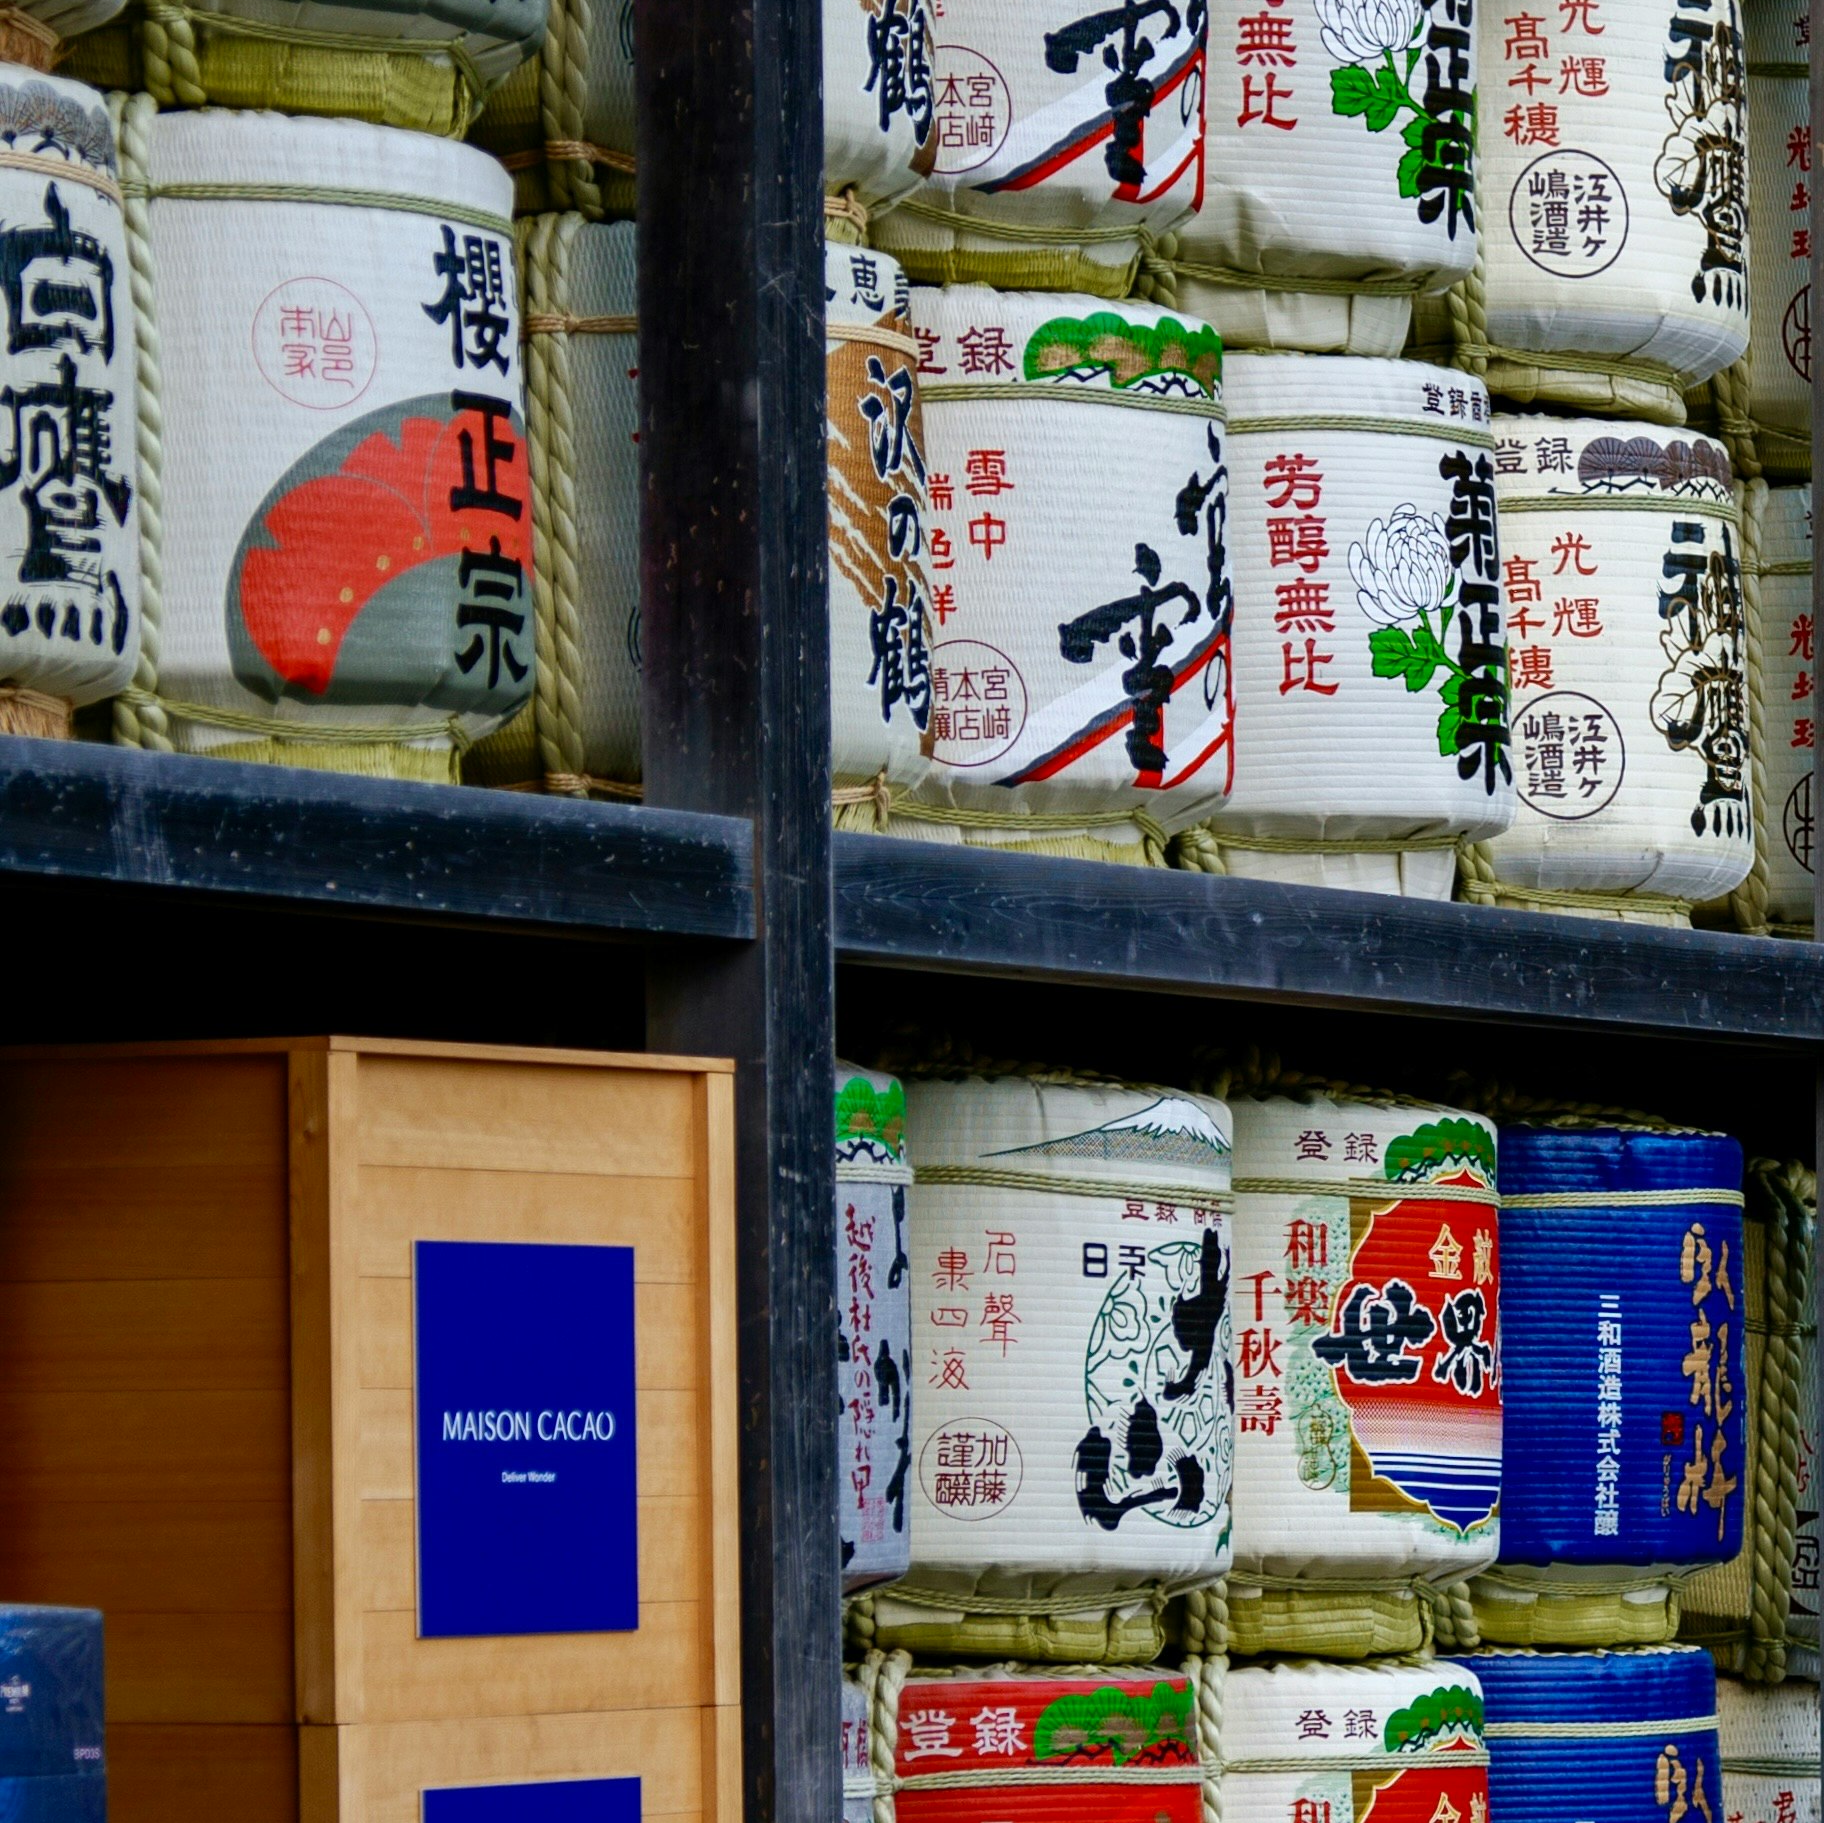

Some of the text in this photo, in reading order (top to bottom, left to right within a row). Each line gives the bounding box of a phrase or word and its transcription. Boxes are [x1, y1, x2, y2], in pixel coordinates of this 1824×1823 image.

[964, 448, 1015, 561] 雪中
[856, 353, 931, 734] 沢の鶴
[1262, 453, 1340, 696] 芳醇無比
[1293, 1129, 1380, 1165] 登録
[1283, 1218, 1331, 1329] 和楽
[442, 1410, 615, 1442] MAISON CACAO
[502, 1471, 556, 1483] Deliver Wonder
[901, 1708, 1028, 1761] 登録
[1296, 1708, 1379, 1741] 登録
